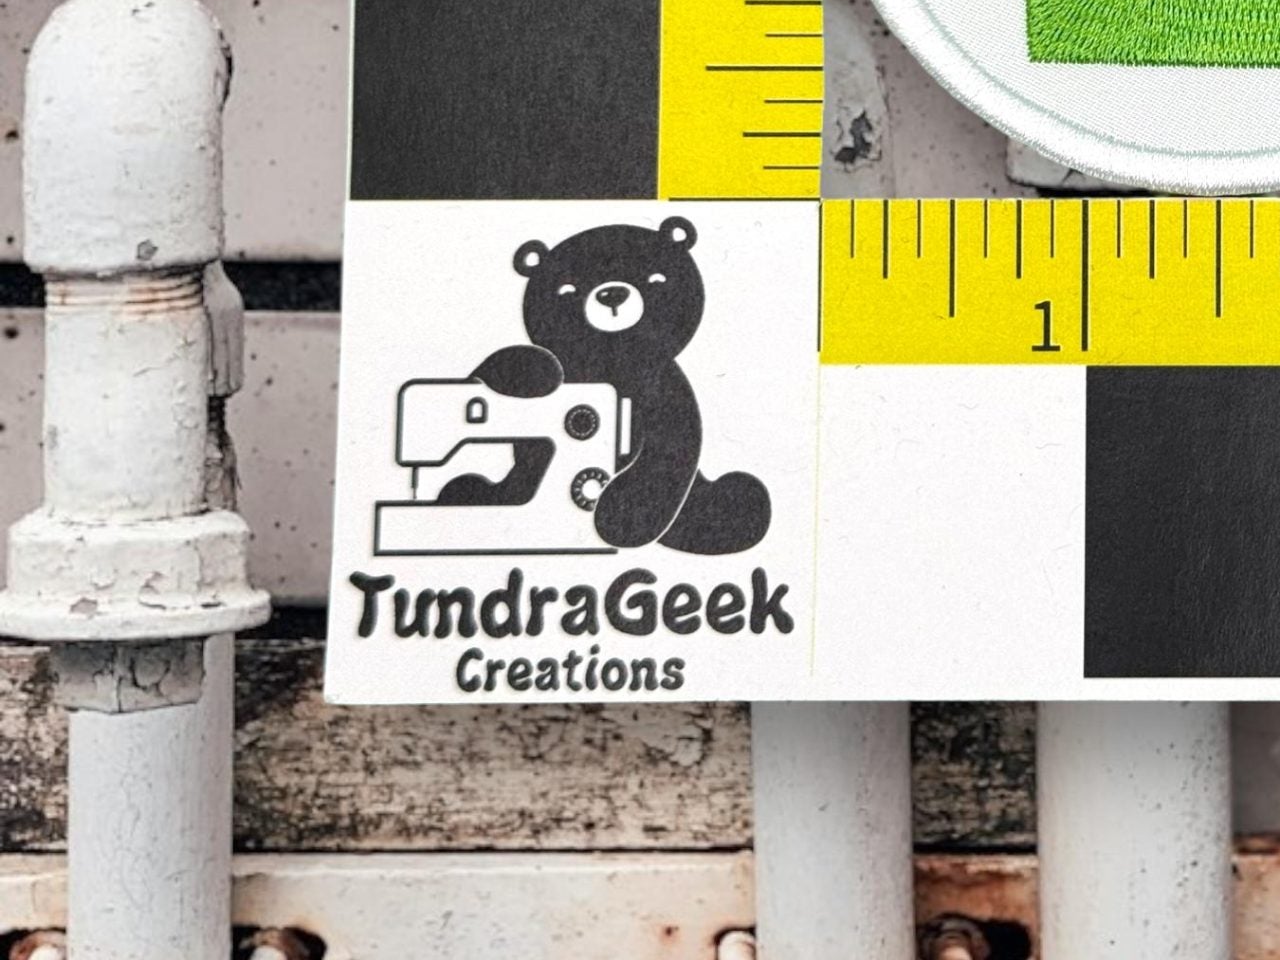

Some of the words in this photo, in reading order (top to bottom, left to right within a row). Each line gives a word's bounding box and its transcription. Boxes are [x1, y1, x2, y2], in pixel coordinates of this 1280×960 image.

[1031, 300, 1061, 352] 1
[349, 567, 795, 639] TundraGeek
[455, 644, 686, 693] Creations
